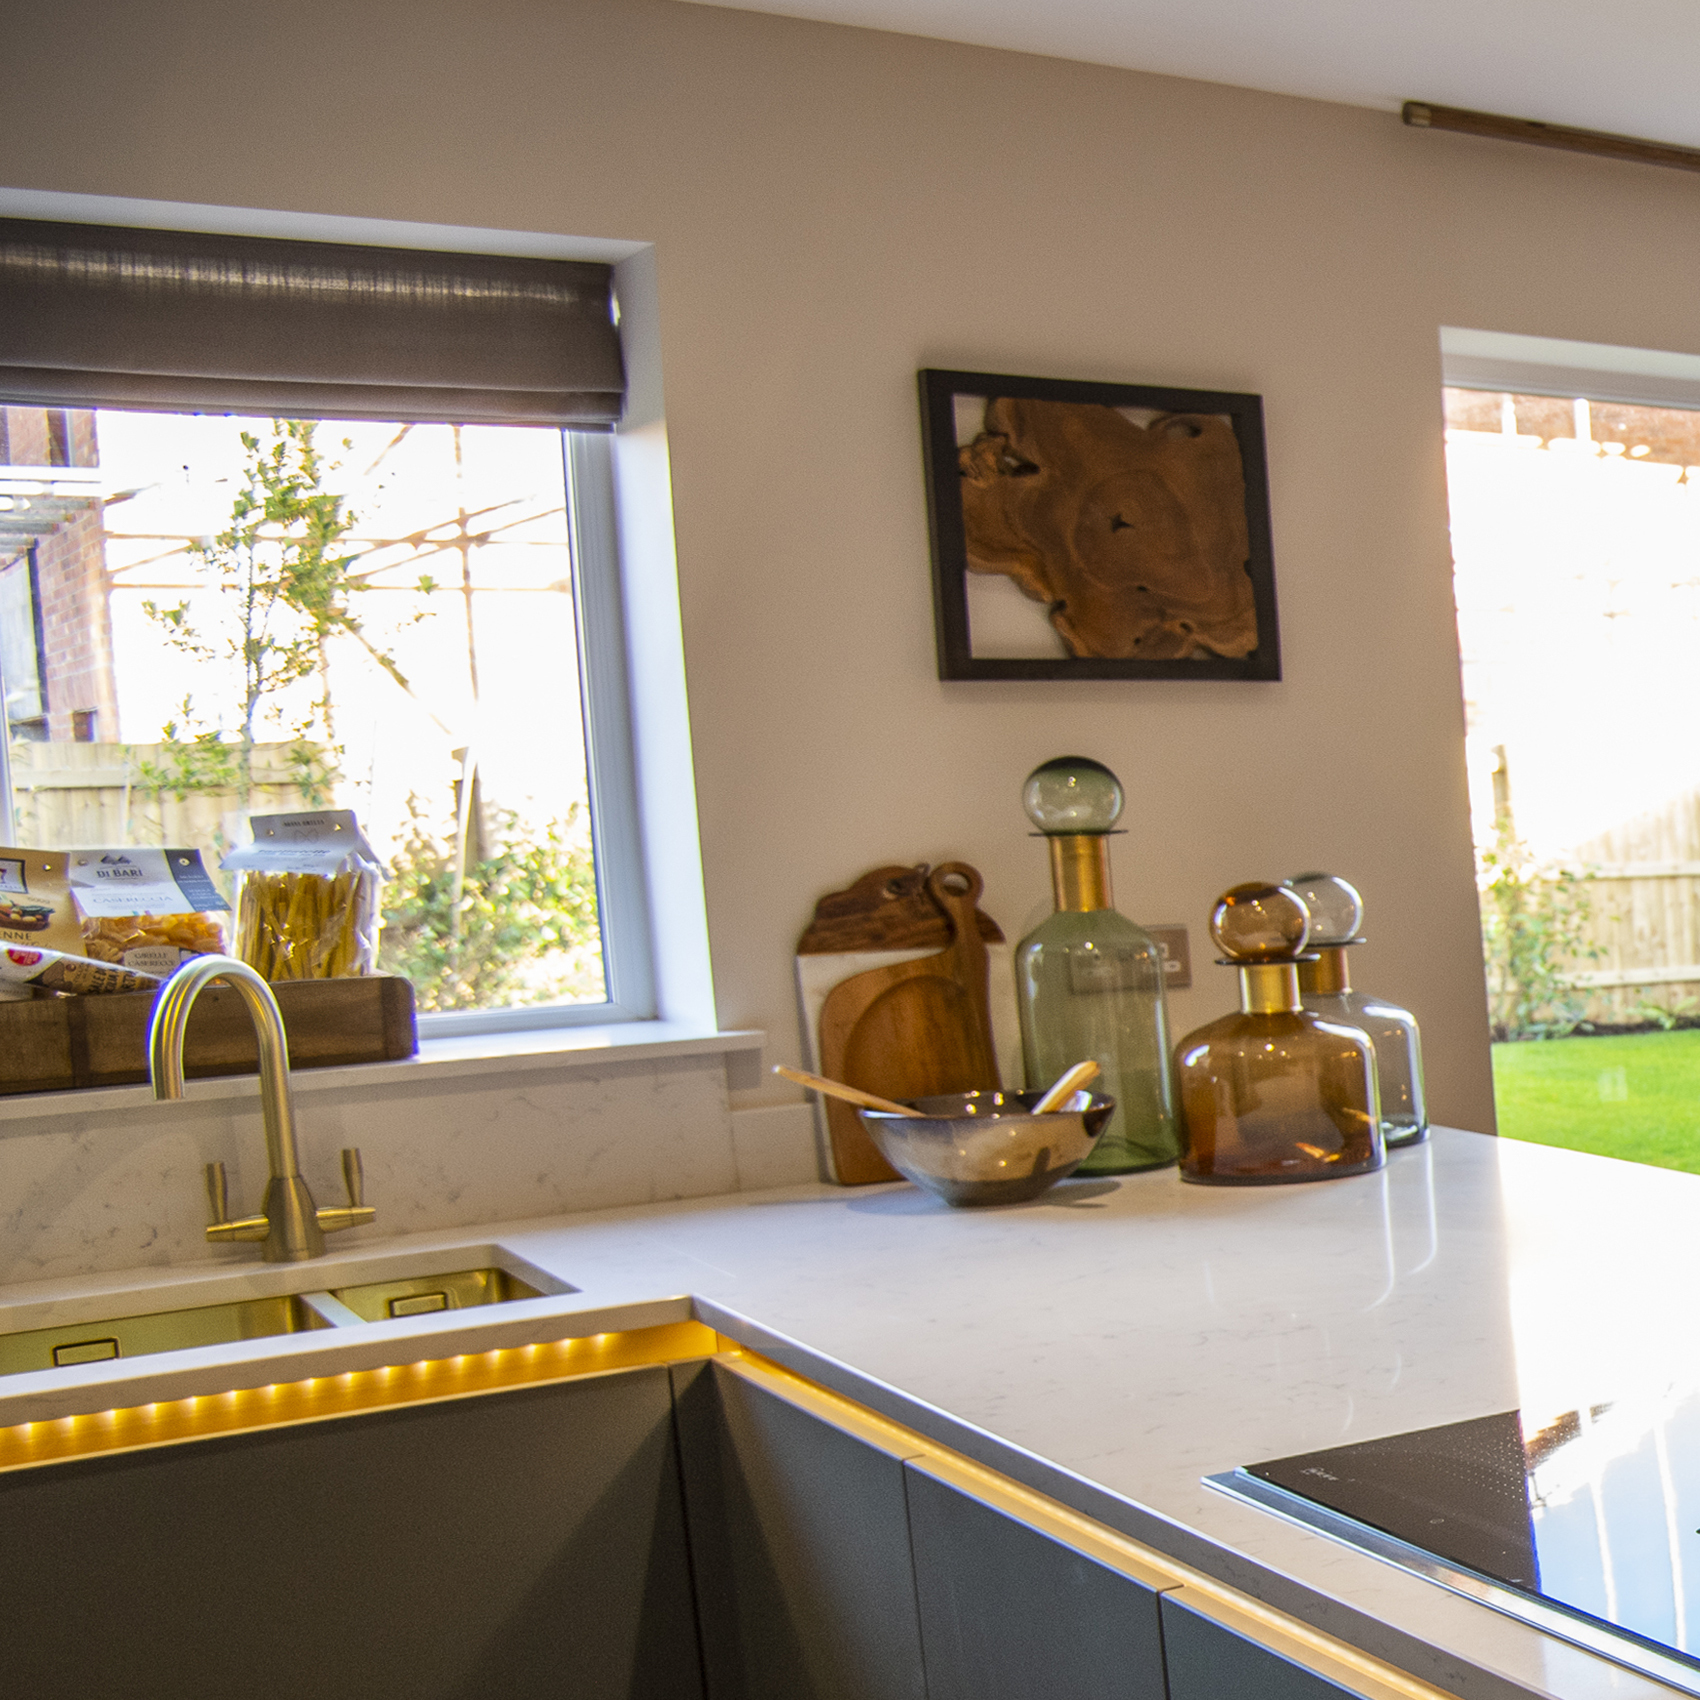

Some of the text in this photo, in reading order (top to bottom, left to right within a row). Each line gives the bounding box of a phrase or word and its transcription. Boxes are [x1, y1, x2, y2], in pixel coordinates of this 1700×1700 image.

[96, 868, 144, 879] DI BARI
[0, 930, 32, 941] NNE
